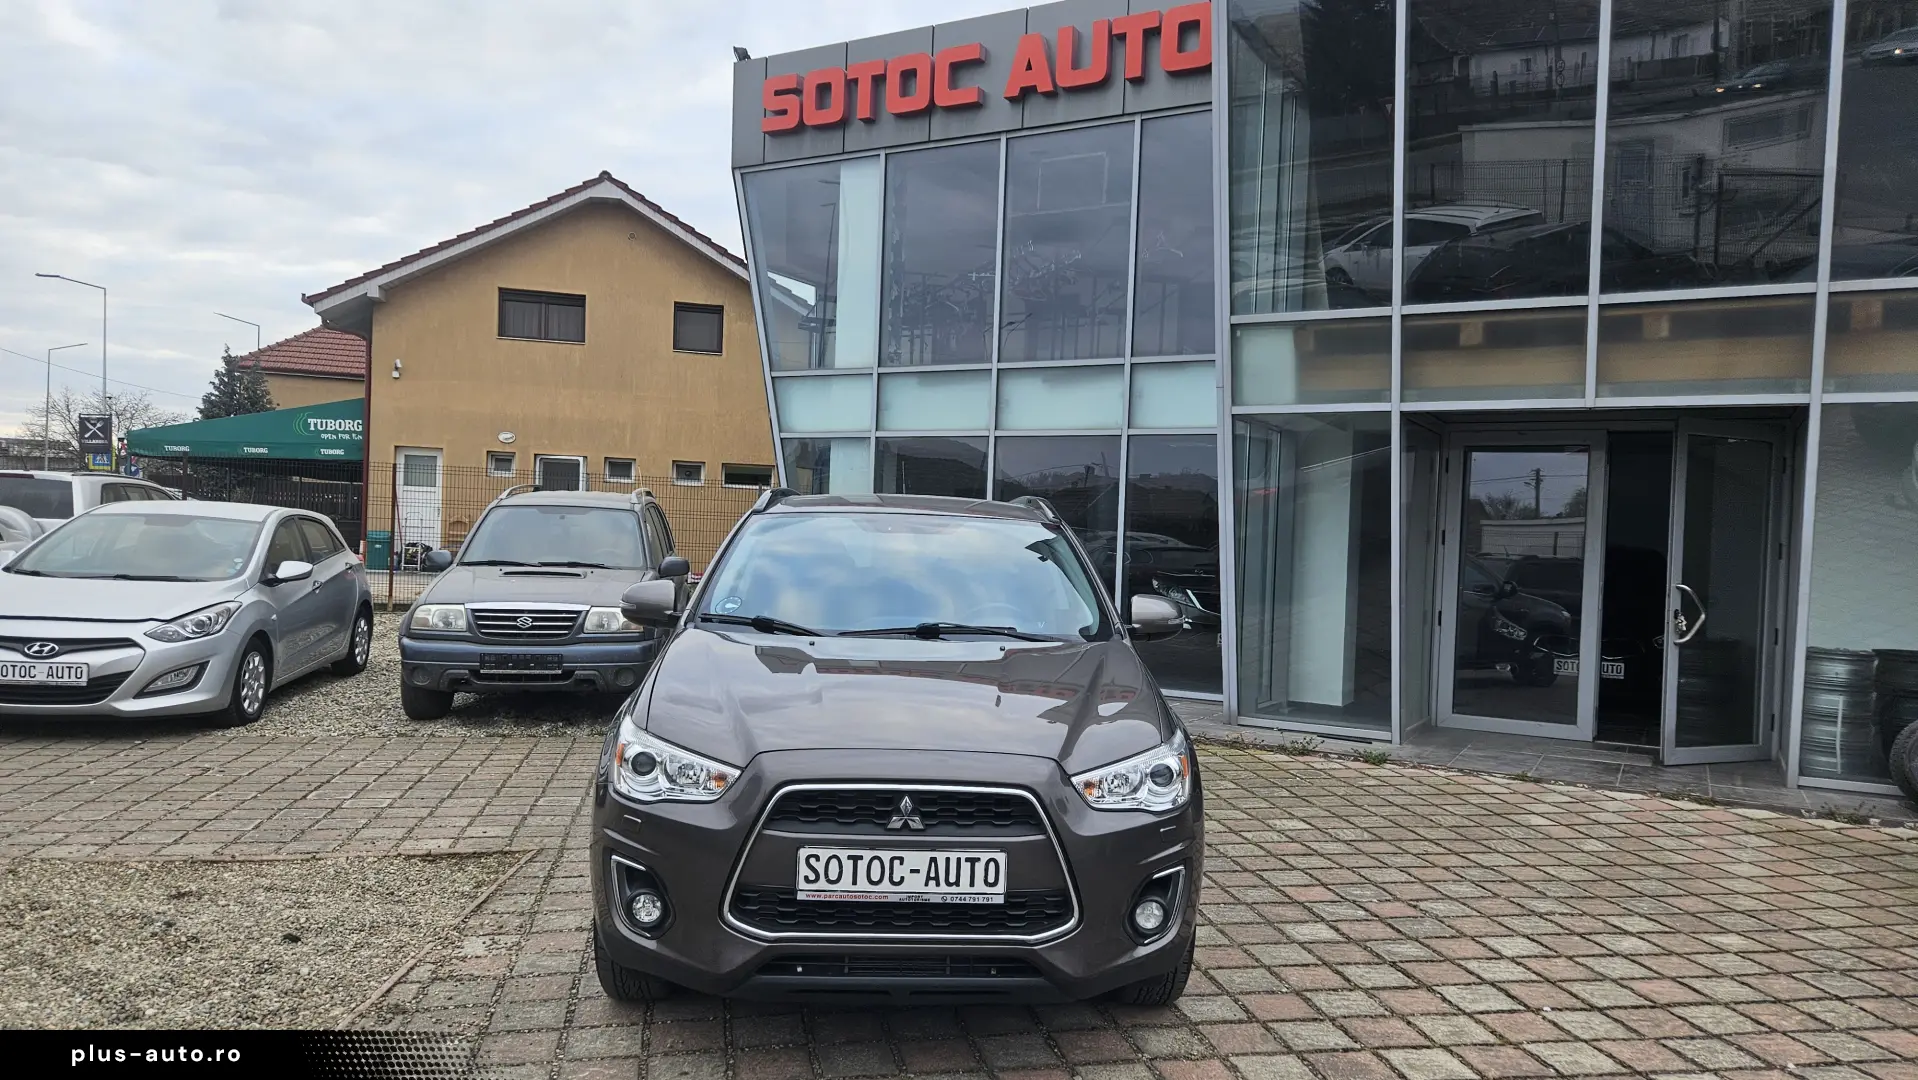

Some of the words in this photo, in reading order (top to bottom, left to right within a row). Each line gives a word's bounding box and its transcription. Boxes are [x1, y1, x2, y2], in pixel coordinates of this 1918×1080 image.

[761, 42, 987, 135] SOTOC
[1003, 2, 1212, 102] AUTO
[307, 418, 363, 431] TUBORG
[0, 664, 84, 680] OTOC-AUTO
[803, 853, 1001, 888] SOTOC-AUTO
